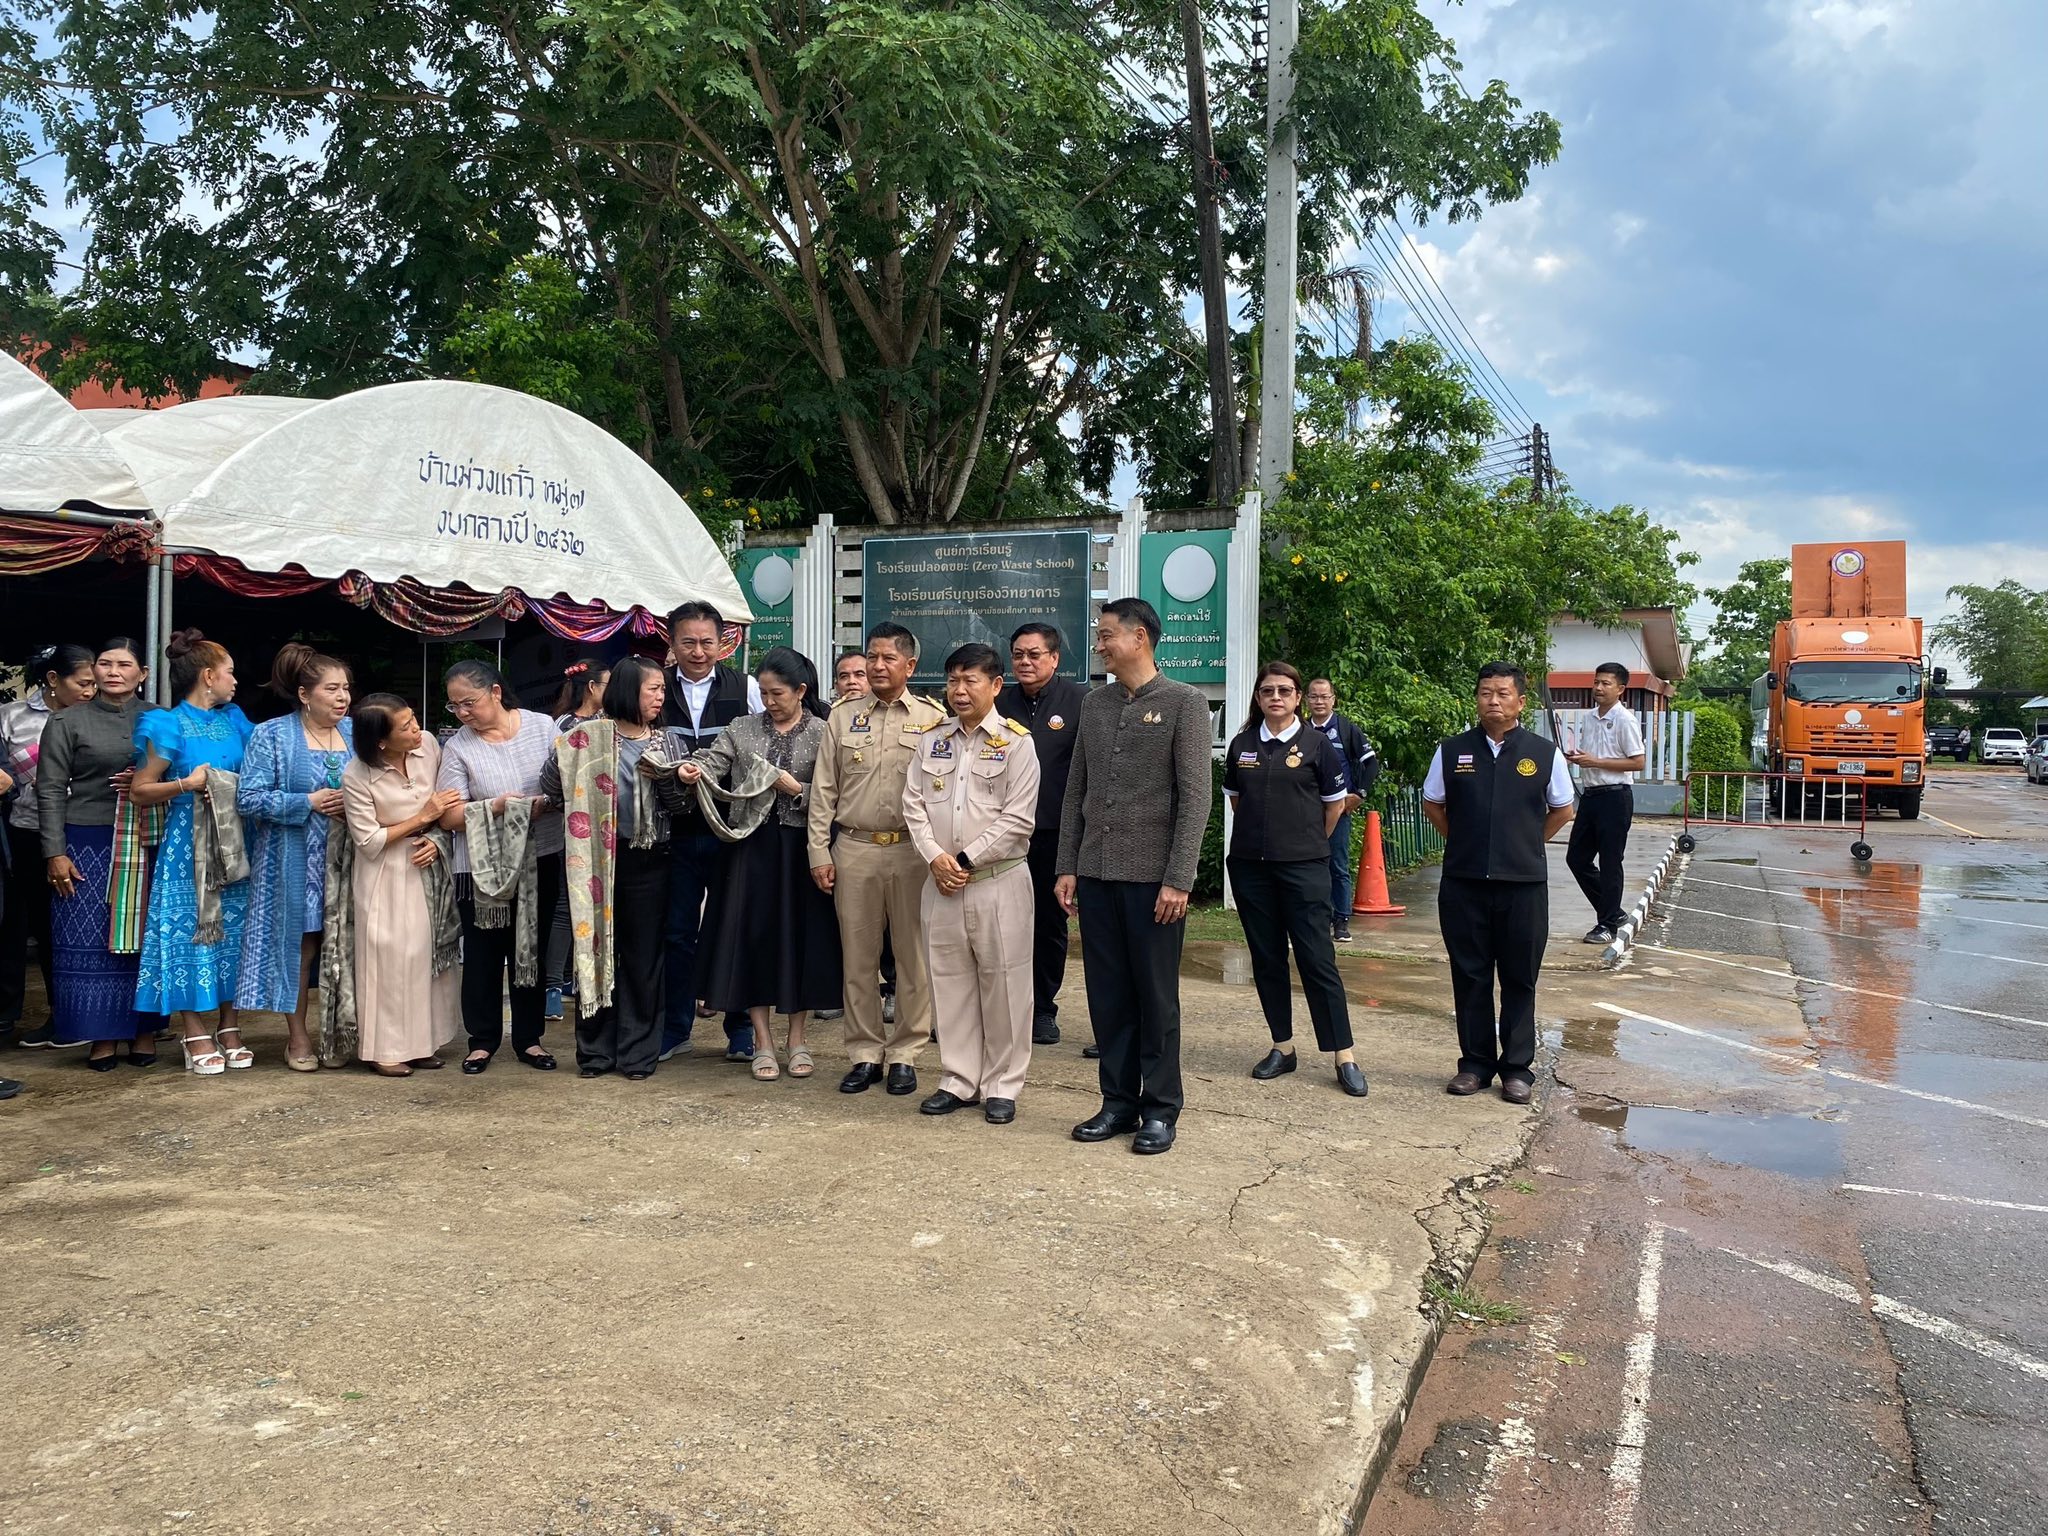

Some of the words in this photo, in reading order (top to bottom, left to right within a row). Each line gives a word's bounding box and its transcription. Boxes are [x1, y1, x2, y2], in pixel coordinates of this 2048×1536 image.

[419, 451, 534, 499] บ้านม่วงแก้ว
[437, 510, 528, 544] งบกลางปี
[533, 523, 585, 556] ๒๕๖๒
[935, 542, 1013, 560] ศูนย์การเรียนรู้
[876, 560, 969, 574] โรงเรียนปลอดขยะ
[972, 561, 998, 573] (Zero
[1001, 560, 1032, 570] Waste
[1035, 557, 1075, 570] School)
[888, 585, 1061, 603] โรงเรียนศรีบุญเรืองวิทยาคาร
[1045, 606, 1057, 614] 19
